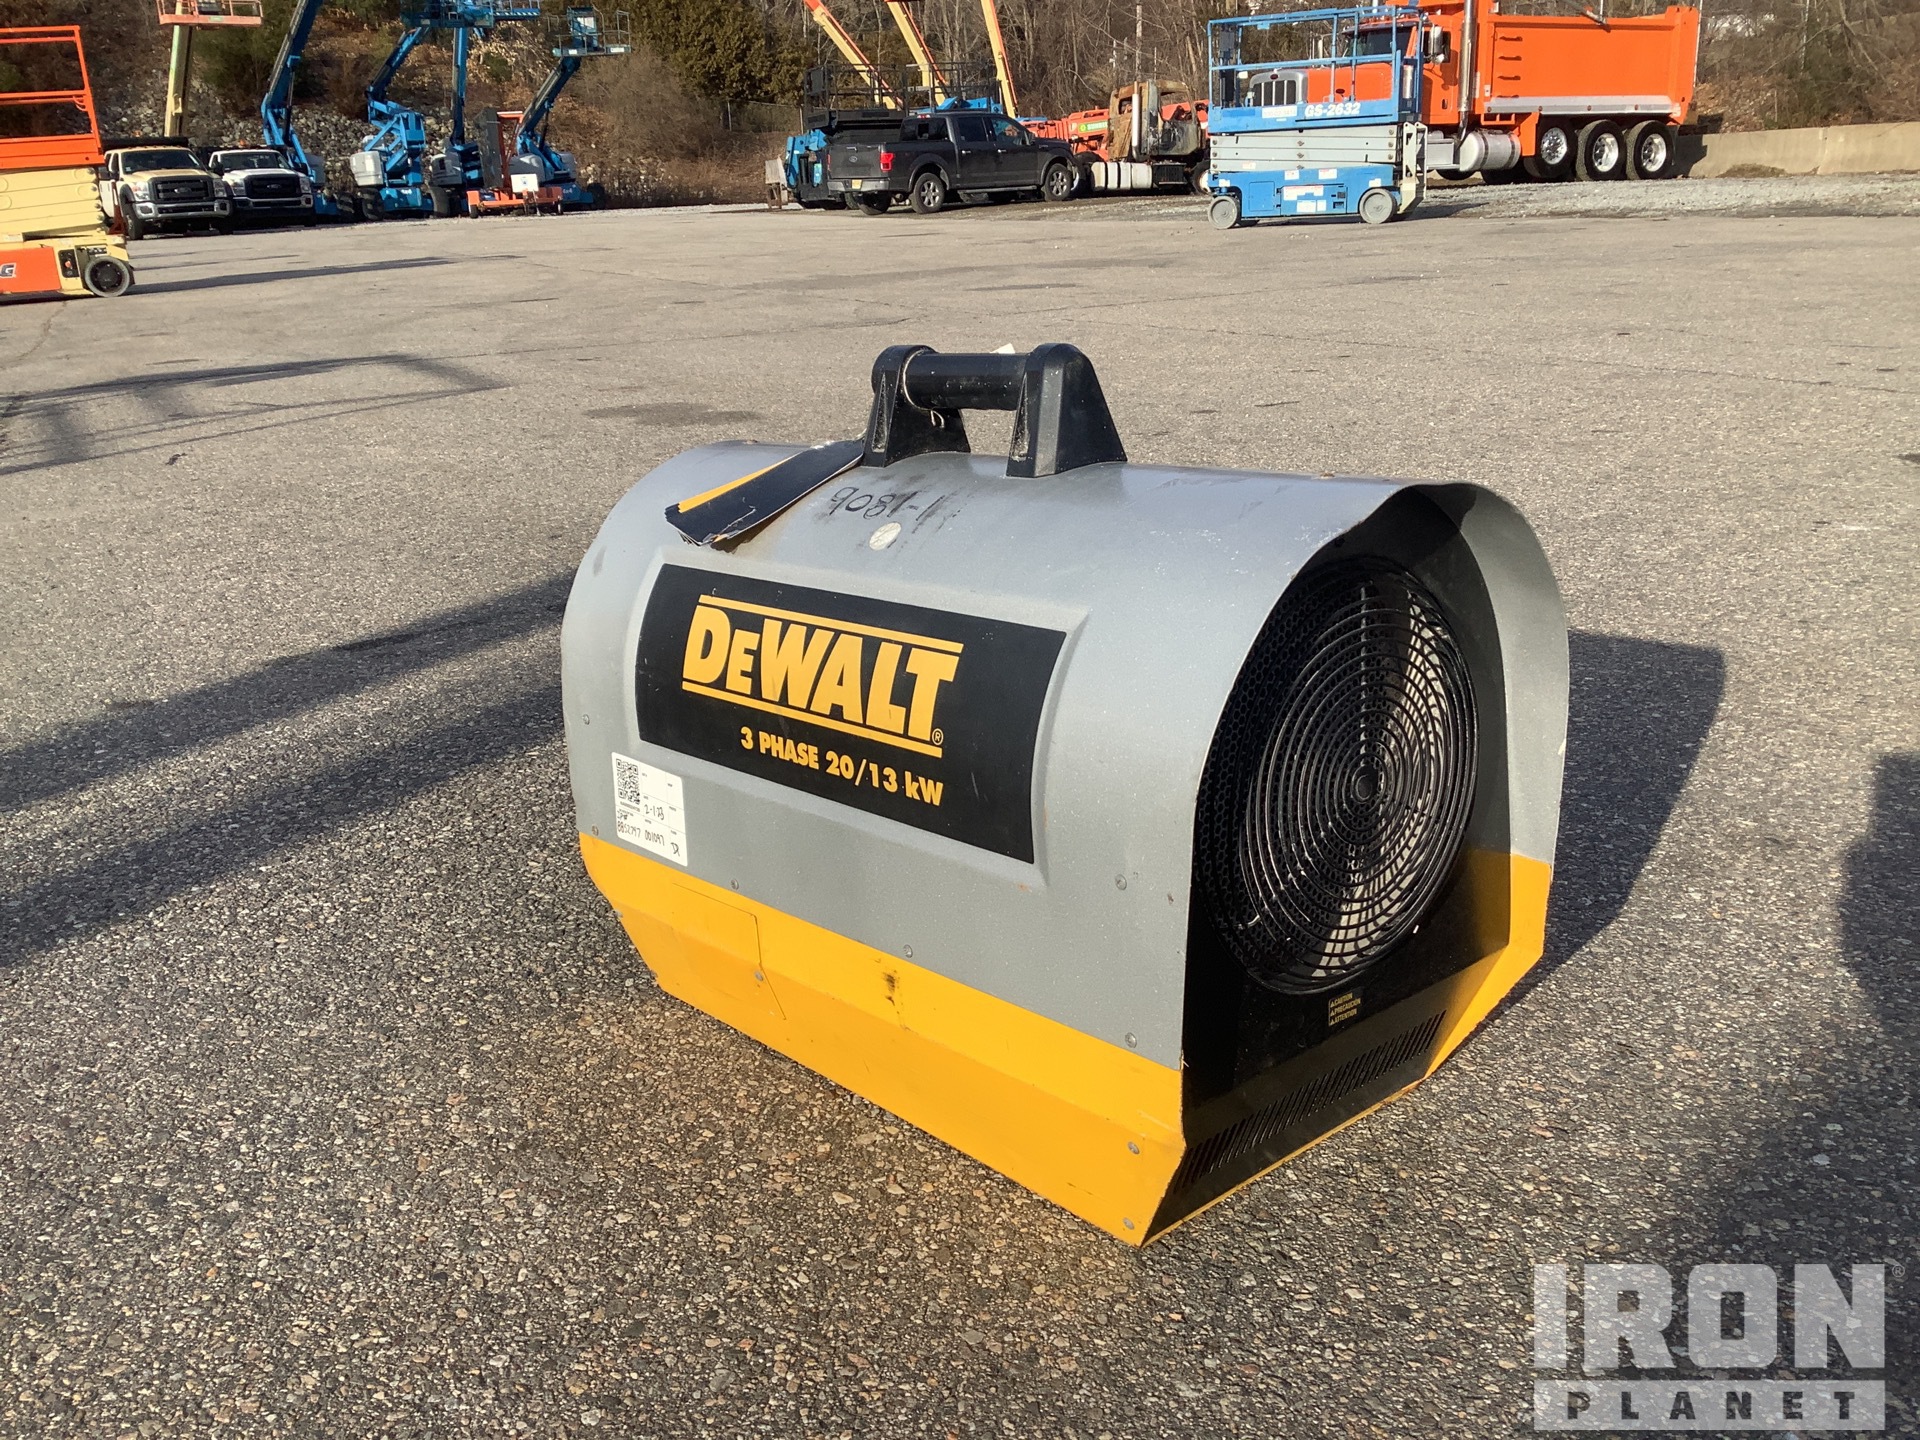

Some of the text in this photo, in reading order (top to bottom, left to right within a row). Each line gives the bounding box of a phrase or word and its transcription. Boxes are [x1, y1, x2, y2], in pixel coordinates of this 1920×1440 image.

[1304, 102, 1361, 117] GS-2632
[740, 726, 944, 807] 3 PHASE 20/13 kW
